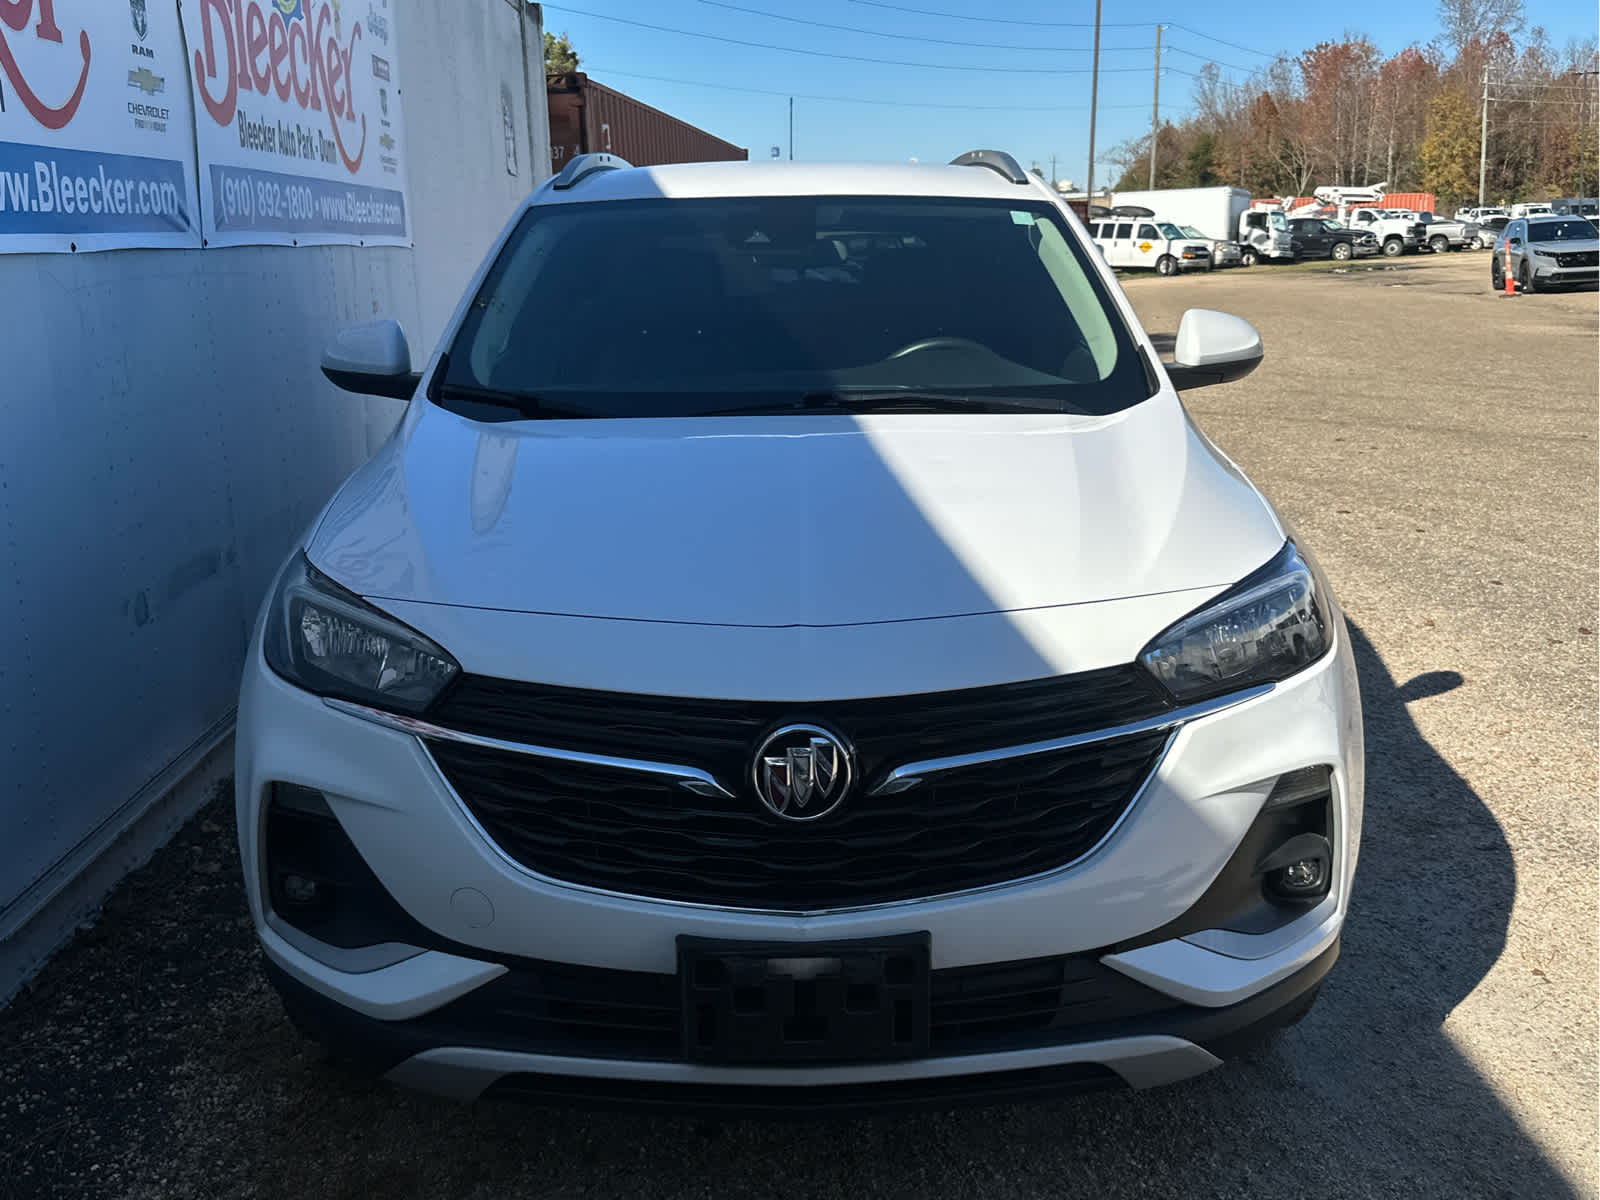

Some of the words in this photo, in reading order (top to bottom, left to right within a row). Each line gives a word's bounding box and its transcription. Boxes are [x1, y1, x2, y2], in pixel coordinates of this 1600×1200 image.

[132, 44, 154, 58] RAM
[127, 102, 169, 120] CHEVROLET
[237, 109, 276, 154] Bleecker
[278, 119, 297, 157] Auto
[296, 123, 315, 160] Park
[0, 160, 179, 215] w.Bleecker.com
[220, 171, 256, 224] (910)
[257, 181, 313, 220] 892-1800
[320, 192, 401, 224] www.Bleecker.com
